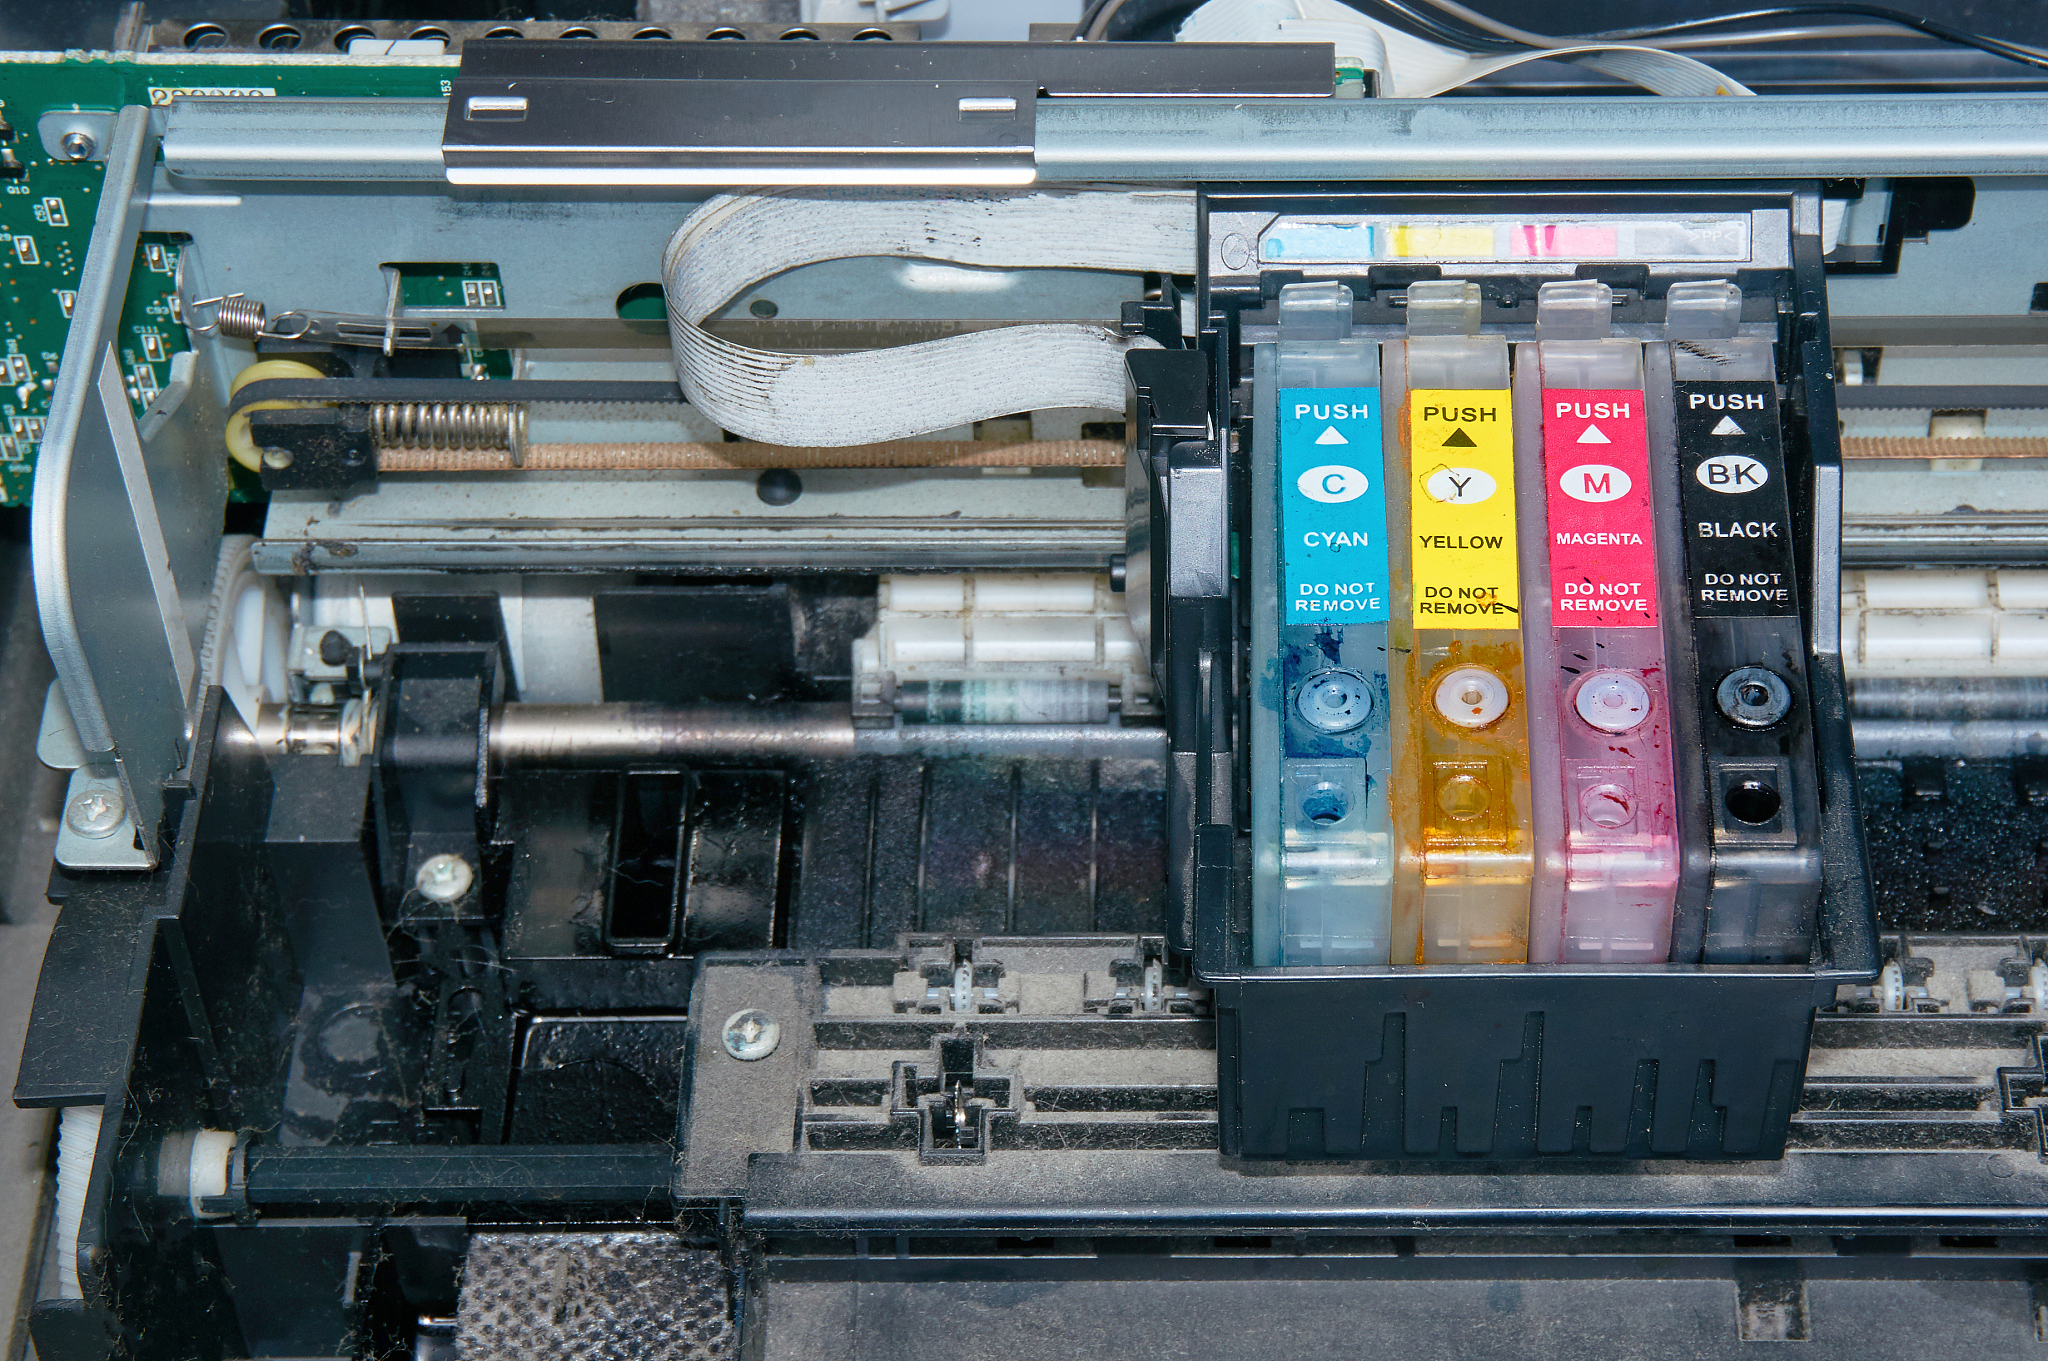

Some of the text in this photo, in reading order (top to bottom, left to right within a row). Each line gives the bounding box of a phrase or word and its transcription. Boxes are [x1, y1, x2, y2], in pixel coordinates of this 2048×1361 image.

[1689, 393, 1764, 410] PUSH
[1295, 403, 1368, 421] PUSH
[1423, 406, 1497, 423] PUSH
[1555, 402, 1630, 419] PUSH
[1708, 463, 1760, 485] BK
[1321, 473, 1346, 495] C
[1448, 476, 1472, 497] Y
[1583, 472, 1611, 494] M
[1698, 521, 1778, 538] BLACK
[1303, 531, 1369, 548] CYAN
[1419, 535, 1503, 549] YELLOW
[1556, 532, 1643, 546] MAGENTA
[1705, 573, 1782, 586] DO NOT
[1299, 582, 1375, 596] DO NOT
[1425, 586, 1499, 599] DO NOT
[1564, 582, 1642, 596] DO NOT
[1701, 589, 1788, 602] REMOVE
[1295, 597, 1381, 612] REMOVE
[1420, 602, 1503, 615] REMOVE
[1560, 598, 1648, 612] REMOVE
